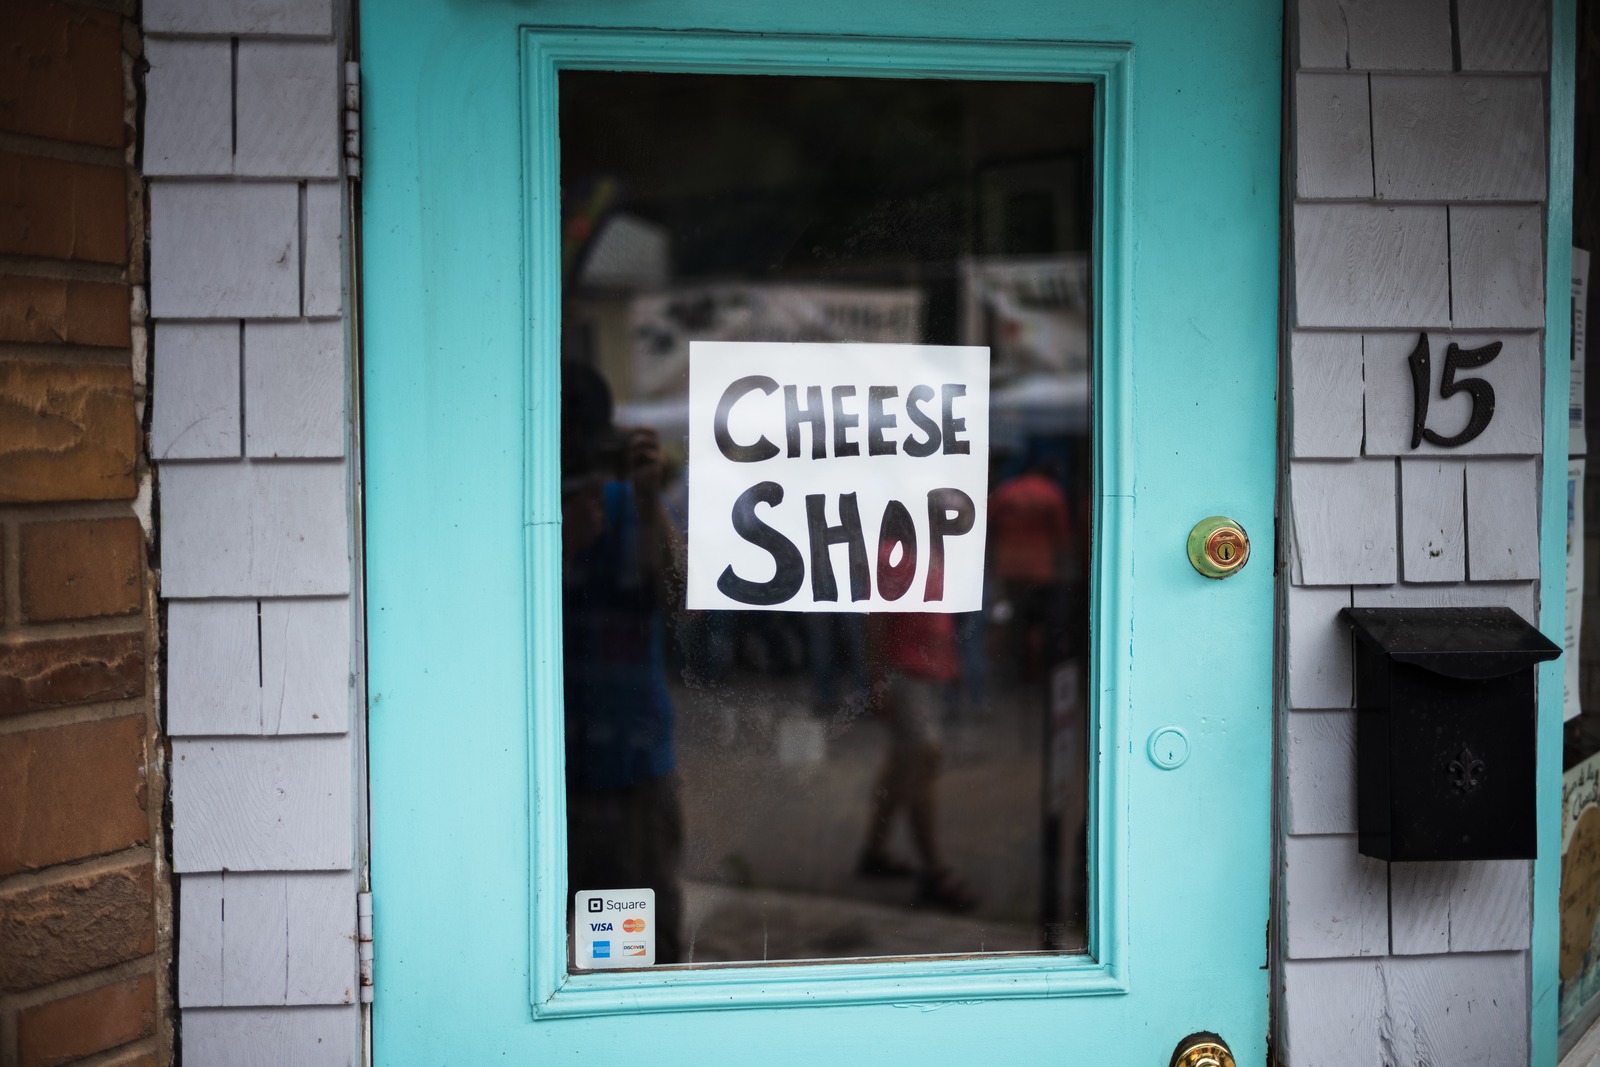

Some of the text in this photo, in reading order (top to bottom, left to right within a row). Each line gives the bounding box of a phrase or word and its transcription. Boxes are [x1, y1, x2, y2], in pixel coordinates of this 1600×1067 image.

[713, 374, 971, 463] CHEESE
[1408, 331, 1503, 449] 15
[716, 480, 976, 606] SHOP
[589, 922, 614, 932] VISA
[606, 899, 646, 912] Square
